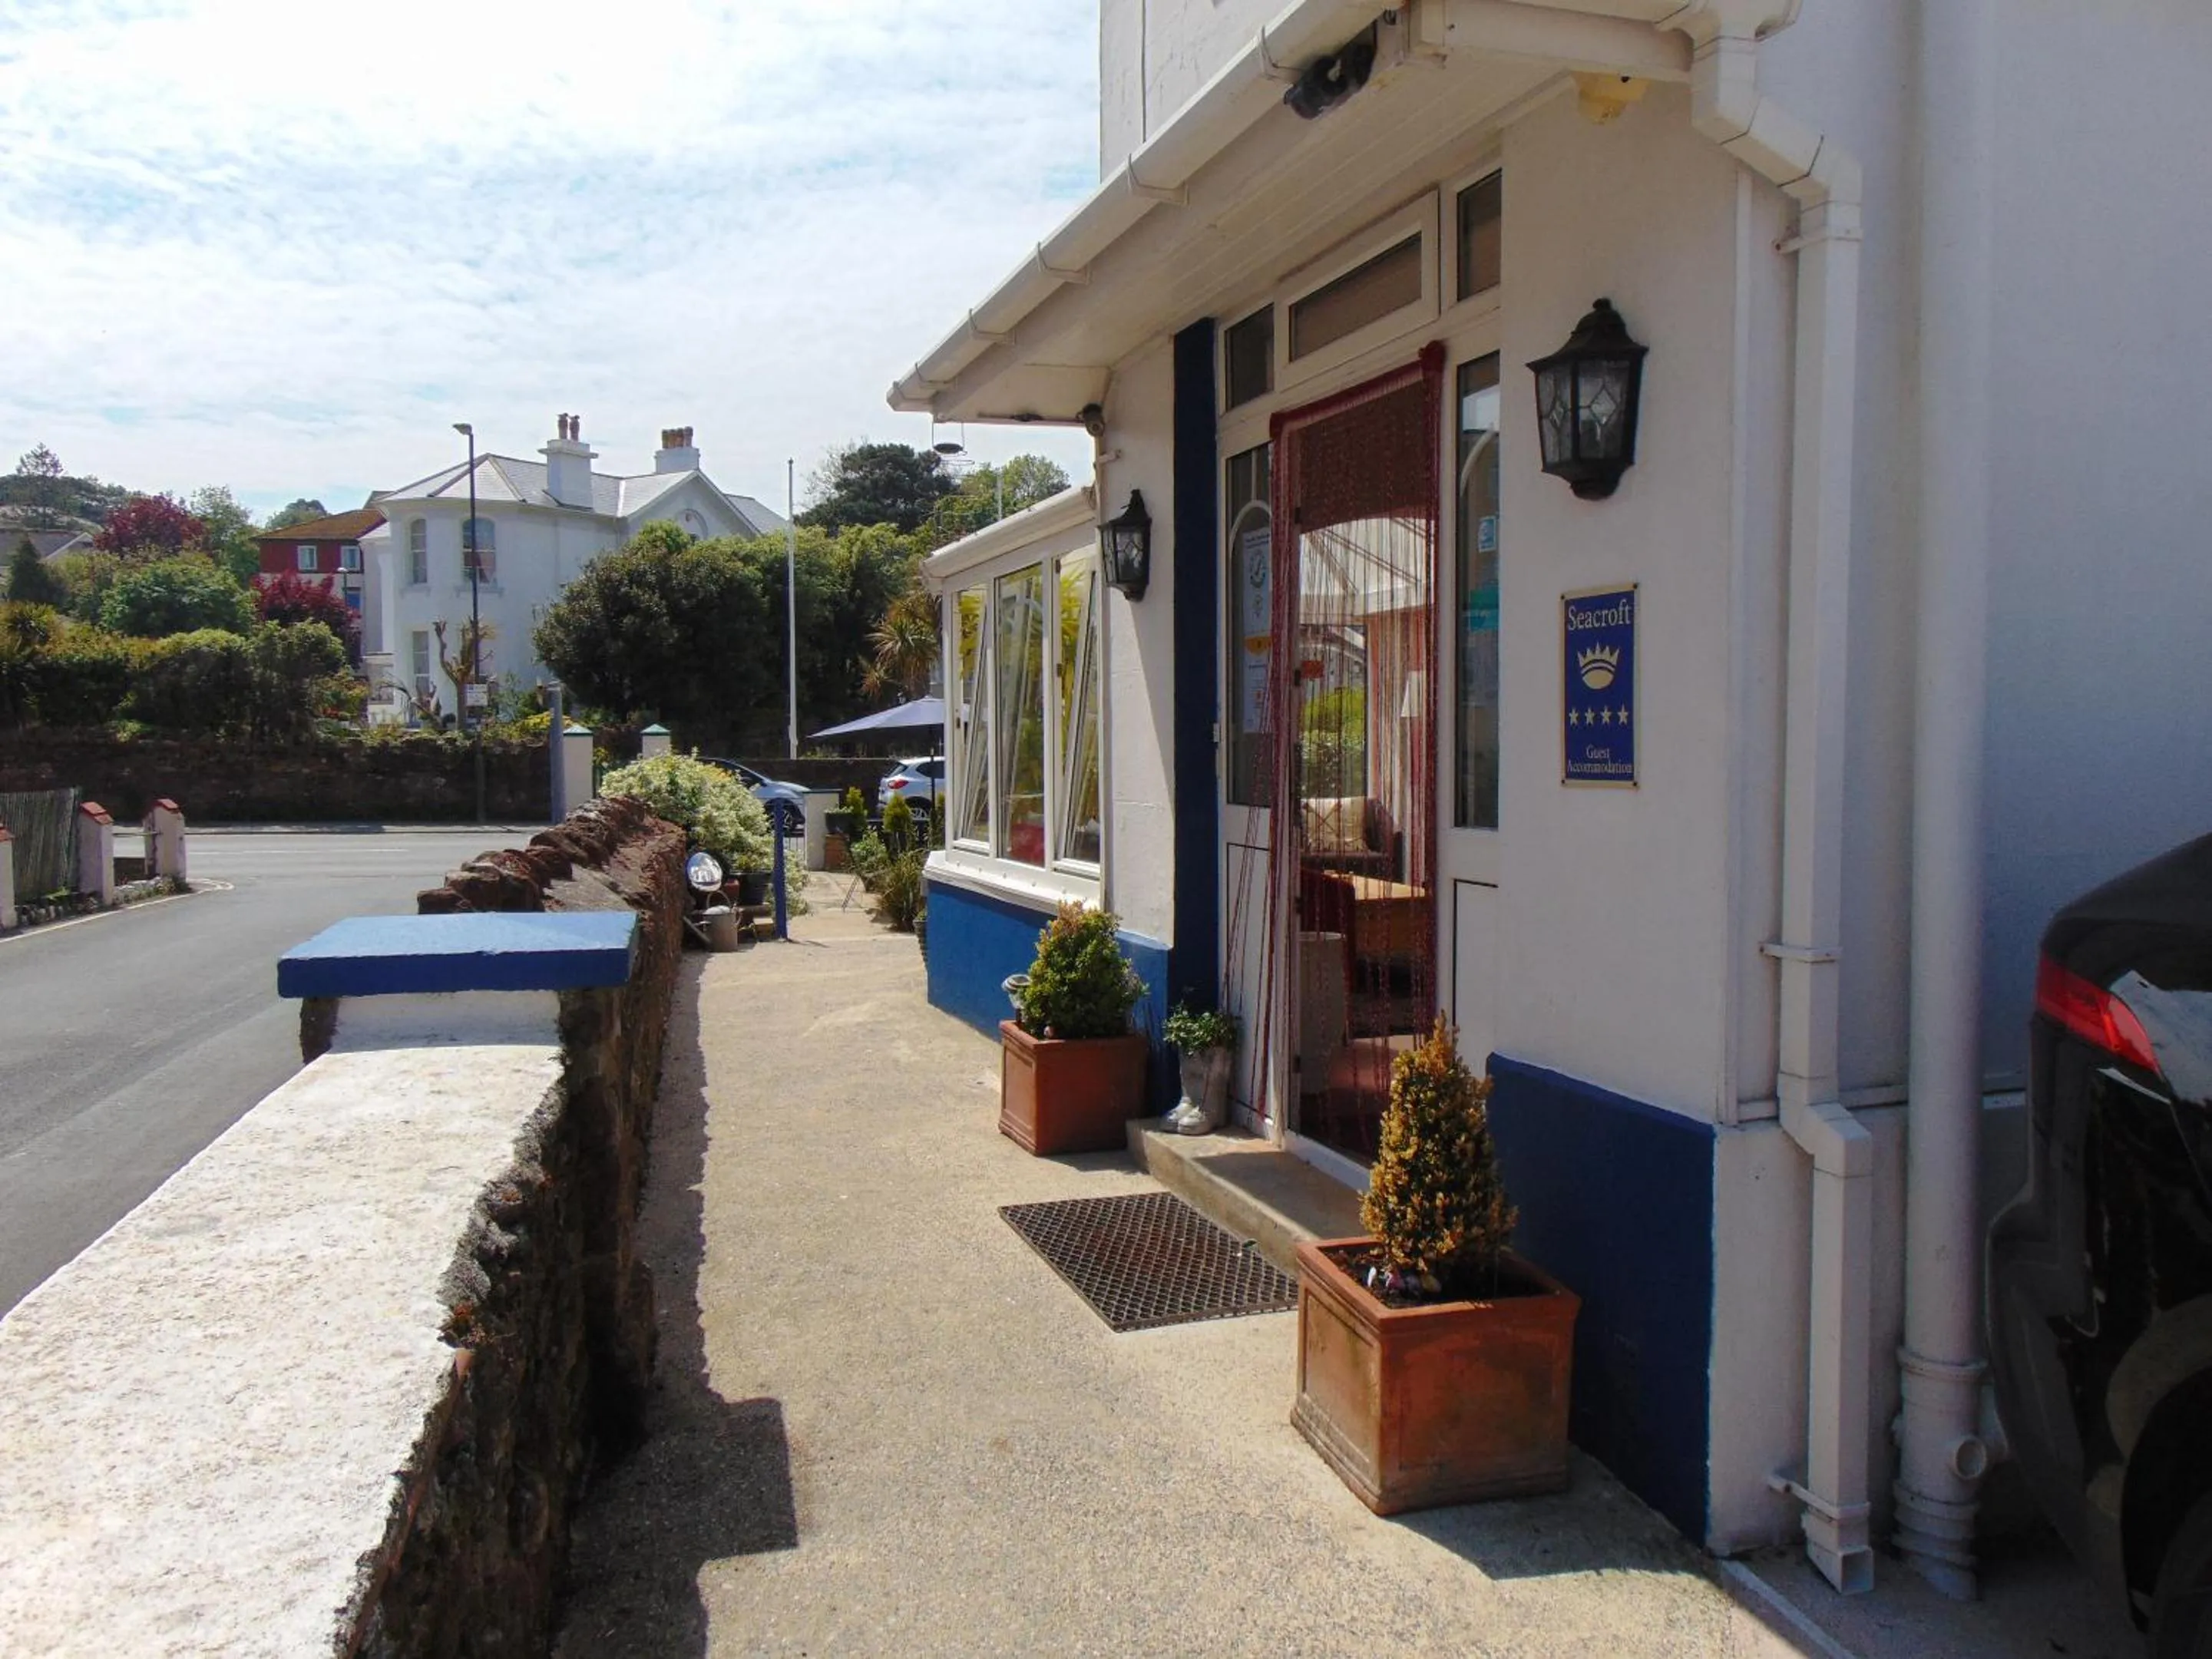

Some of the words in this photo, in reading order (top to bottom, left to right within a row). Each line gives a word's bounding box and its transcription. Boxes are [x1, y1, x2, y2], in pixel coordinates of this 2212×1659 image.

[1568, 598, 1631, 630] Seacroft
[1586, 744, 1610, 758] Guest
[1567, 759, 1632, 774] Accommodation
